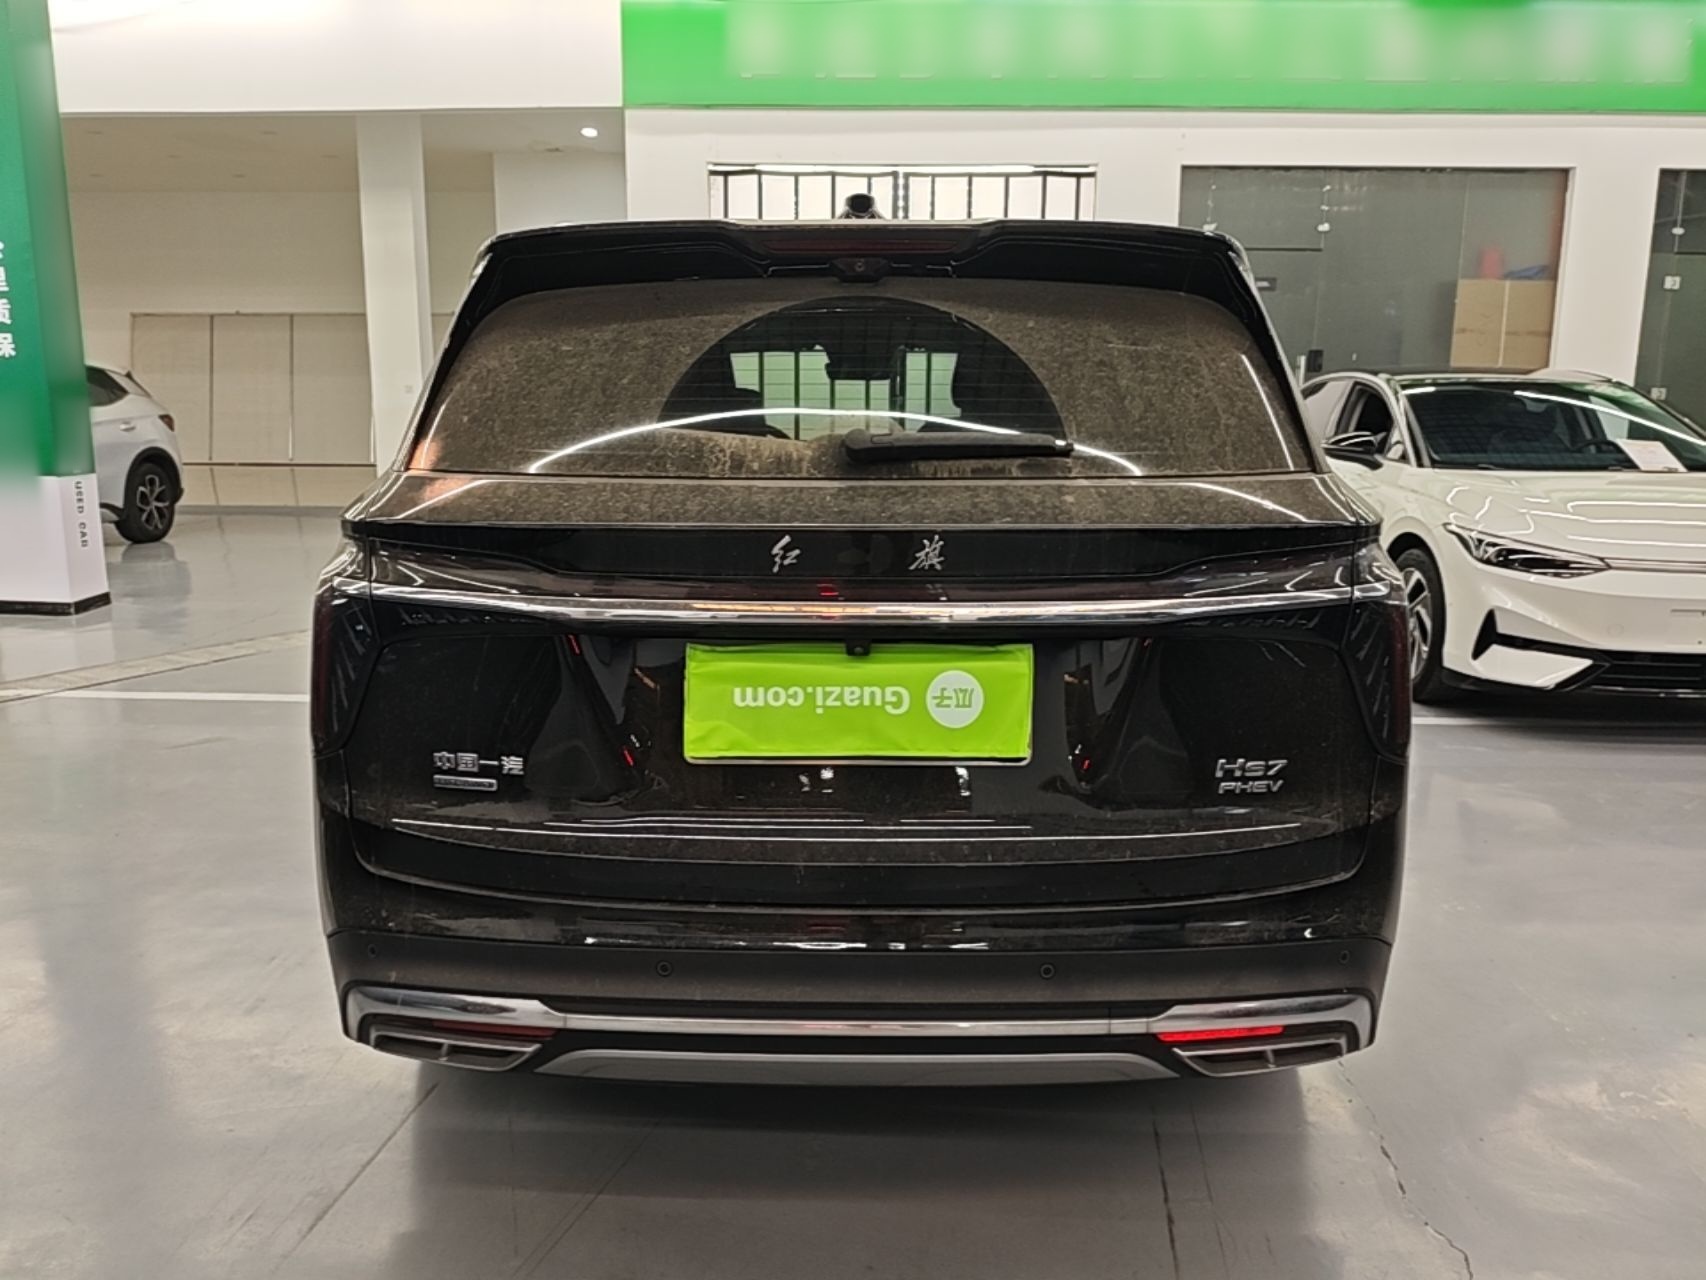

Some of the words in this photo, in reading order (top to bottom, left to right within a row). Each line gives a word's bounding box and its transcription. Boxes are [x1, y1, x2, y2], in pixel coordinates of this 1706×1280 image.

[733, 685, 911, 715] Guazi.com
[931, 686, 975, 710] 瓜子
[432, 751, 525, 775] 中国一汽
[1218, 779, 1284, 795] PHEV
